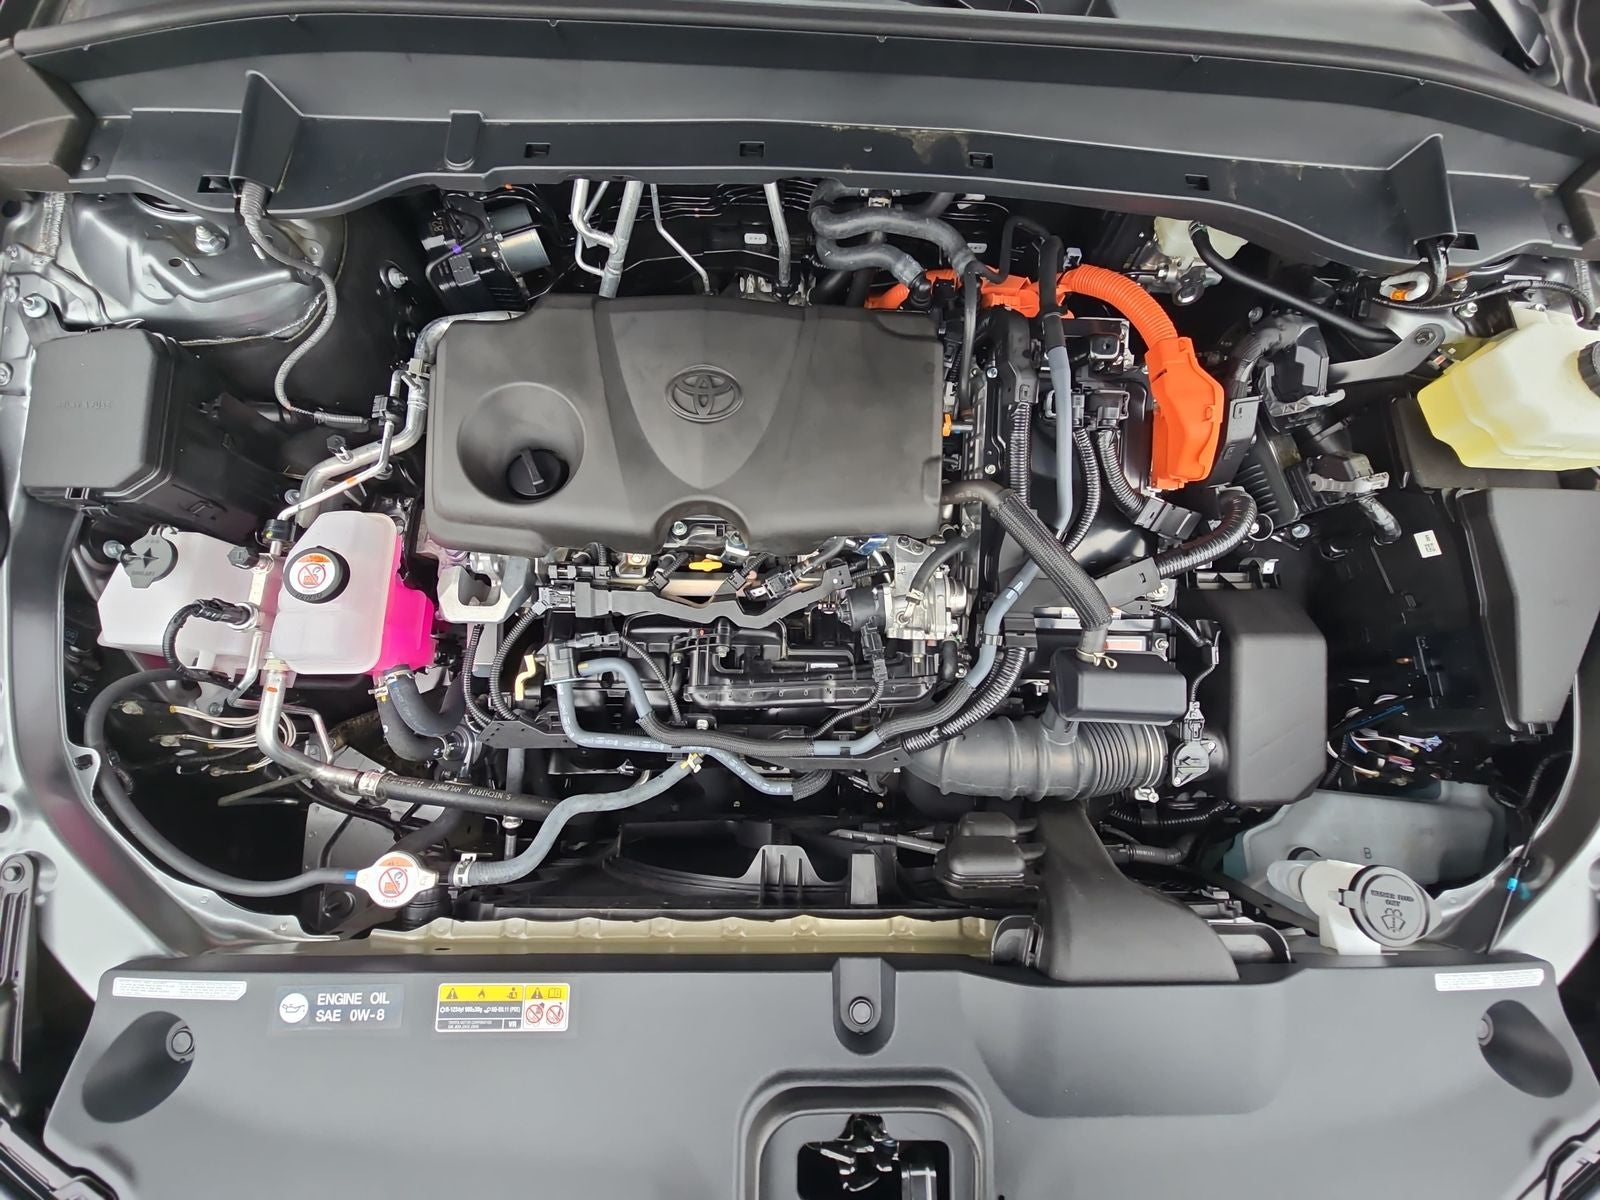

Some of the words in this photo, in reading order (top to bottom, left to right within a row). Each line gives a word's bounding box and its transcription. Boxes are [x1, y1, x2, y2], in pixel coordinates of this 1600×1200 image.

[467, 788, 504, 800] NICHIRIN
[317, 992, 363, 1006] ENGINE
[370, 992, 391, 1005] OIL
[315, 1009, 342, 1023] SAE
[349, 1008, 385, 1022] 0W-8
